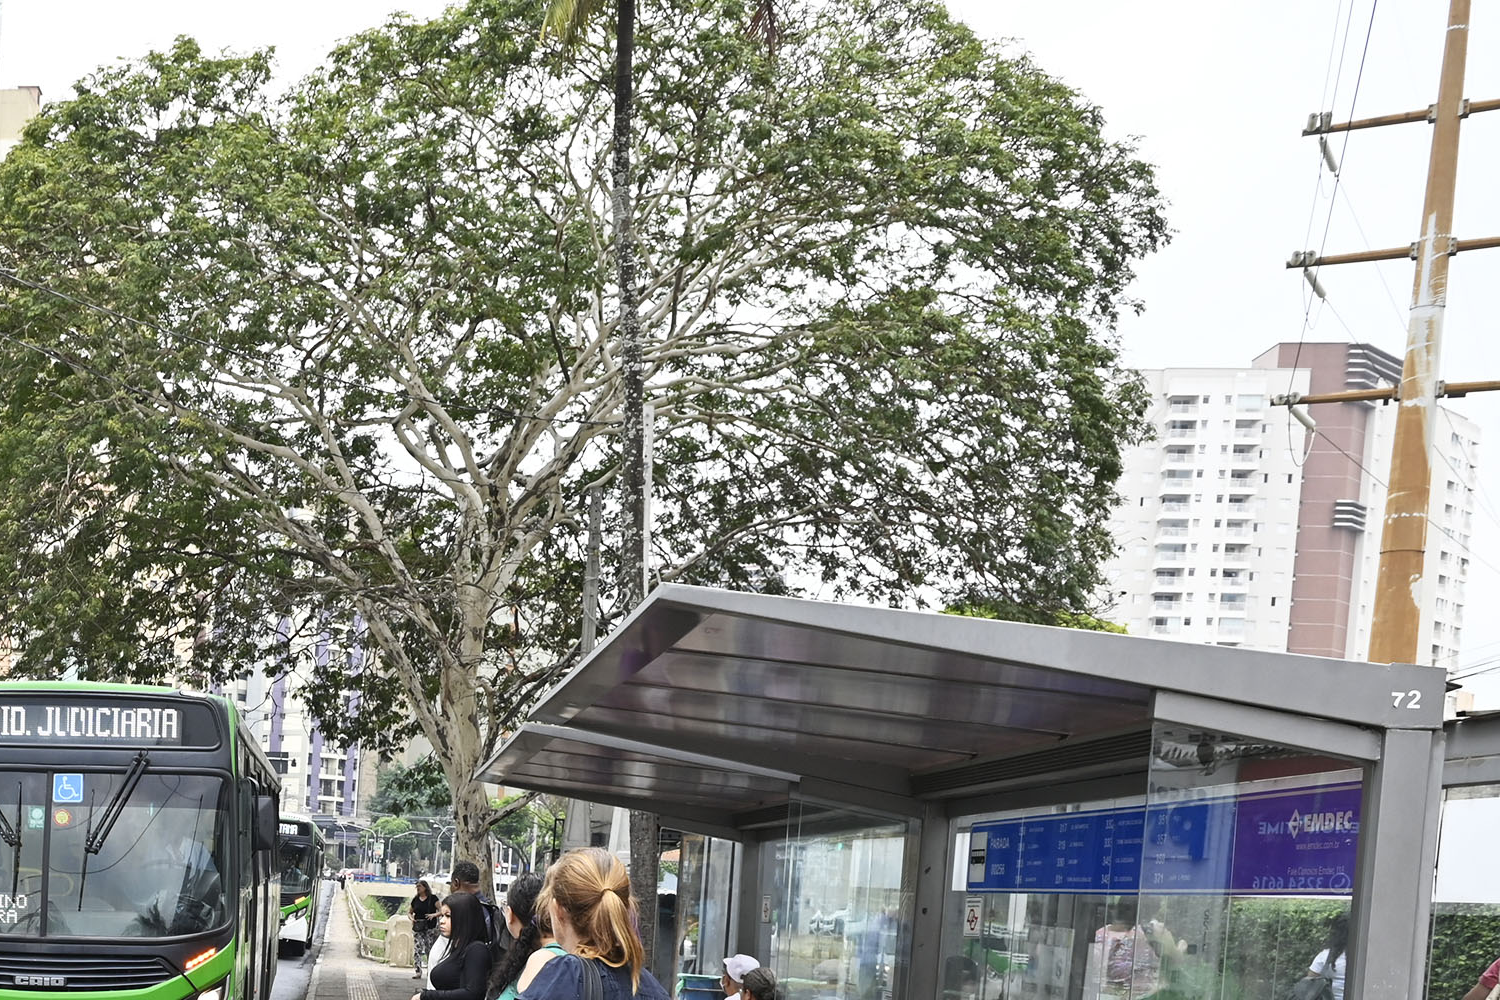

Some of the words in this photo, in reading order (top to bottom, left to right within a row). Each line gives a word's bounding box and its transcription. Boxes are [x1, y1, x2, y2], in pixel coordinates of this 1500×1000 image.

[1391, 690, 1421, 709] 72
[1304, 810, 1353, 832] EMDEC
[14, 975, 66, 986] CAIO
